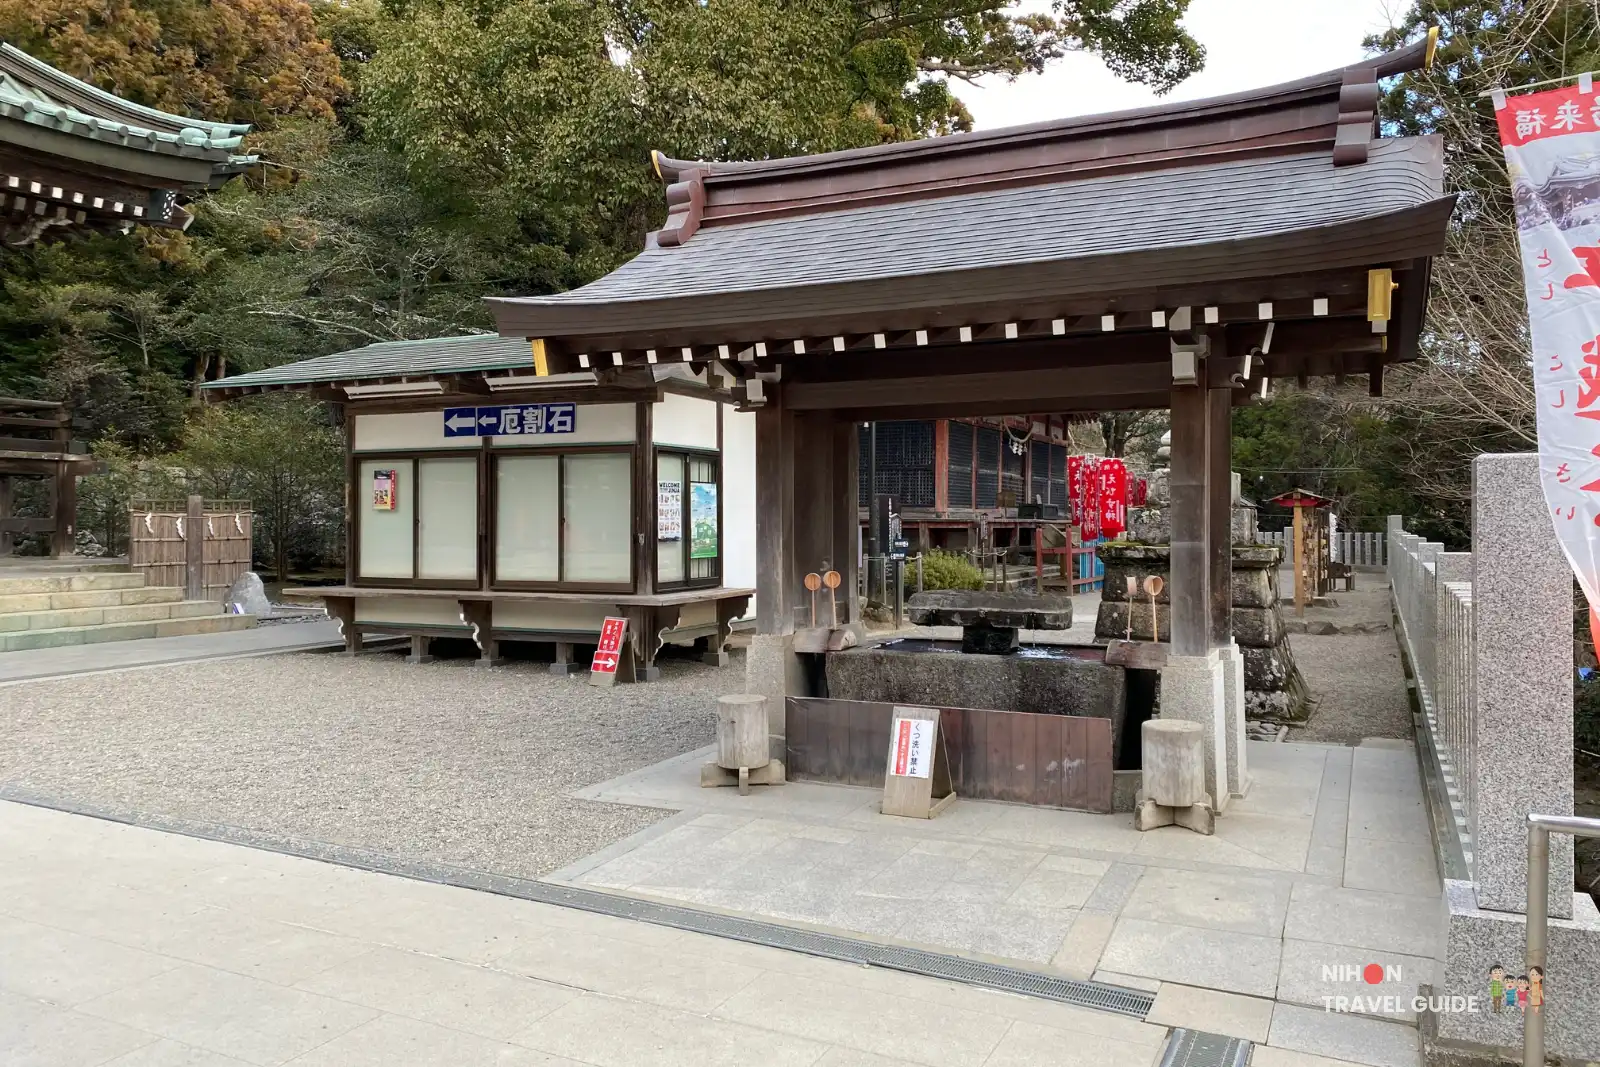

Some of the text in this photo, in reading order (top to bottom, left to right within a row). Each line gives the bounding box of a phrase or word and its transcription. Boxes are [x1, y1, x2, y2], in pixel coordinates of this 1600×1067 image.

[498, 405, 573, 434] 厄割石
[909, 723, 921, 775] くつ洗い禁止
